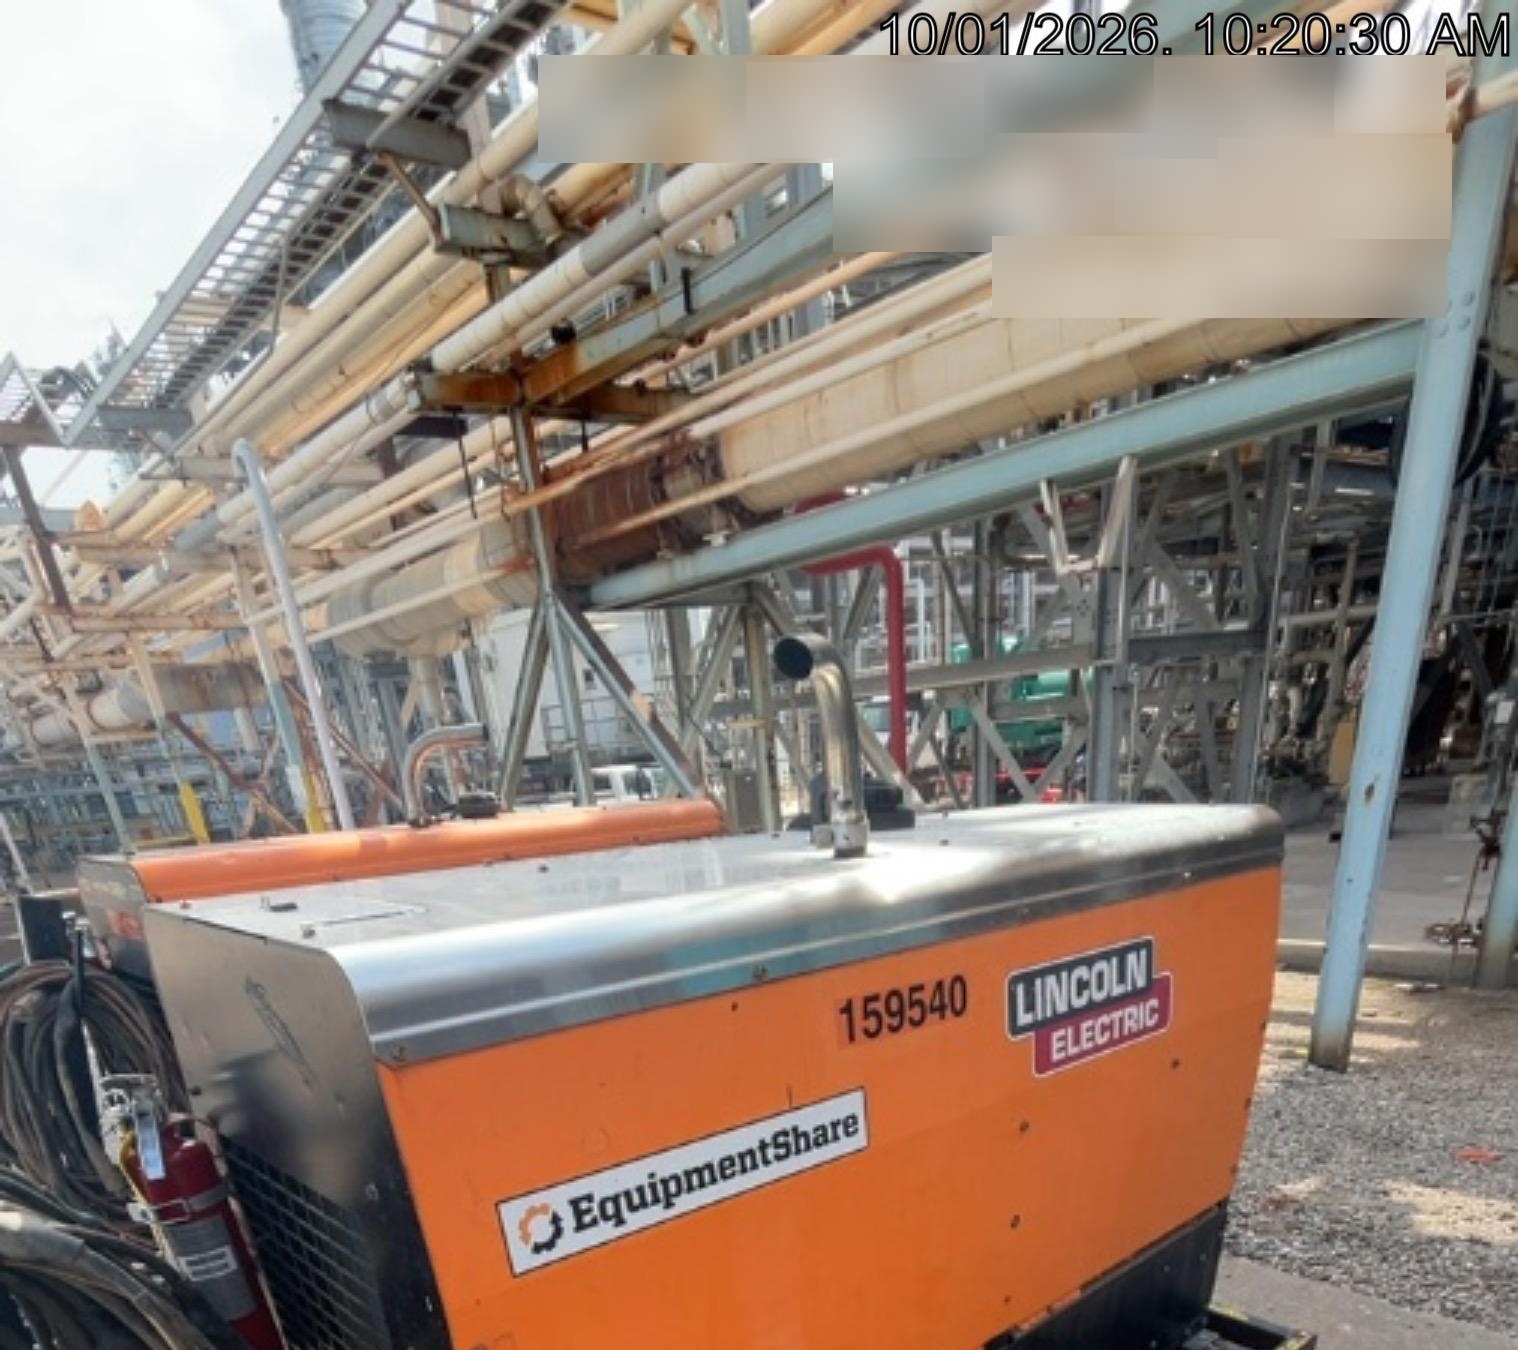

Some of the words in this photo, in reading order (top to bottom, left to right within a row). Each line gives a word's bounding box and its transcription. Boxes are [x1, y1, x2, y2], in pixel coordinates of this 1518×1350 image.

[839, 974, 968, 1043] 159540
[1015, 949, 1148, 1026] LINCOLN
[1050, 999, 1158, 1062] ELECTRIC
[569, 1112, 860, 1233] EquipmentShare
